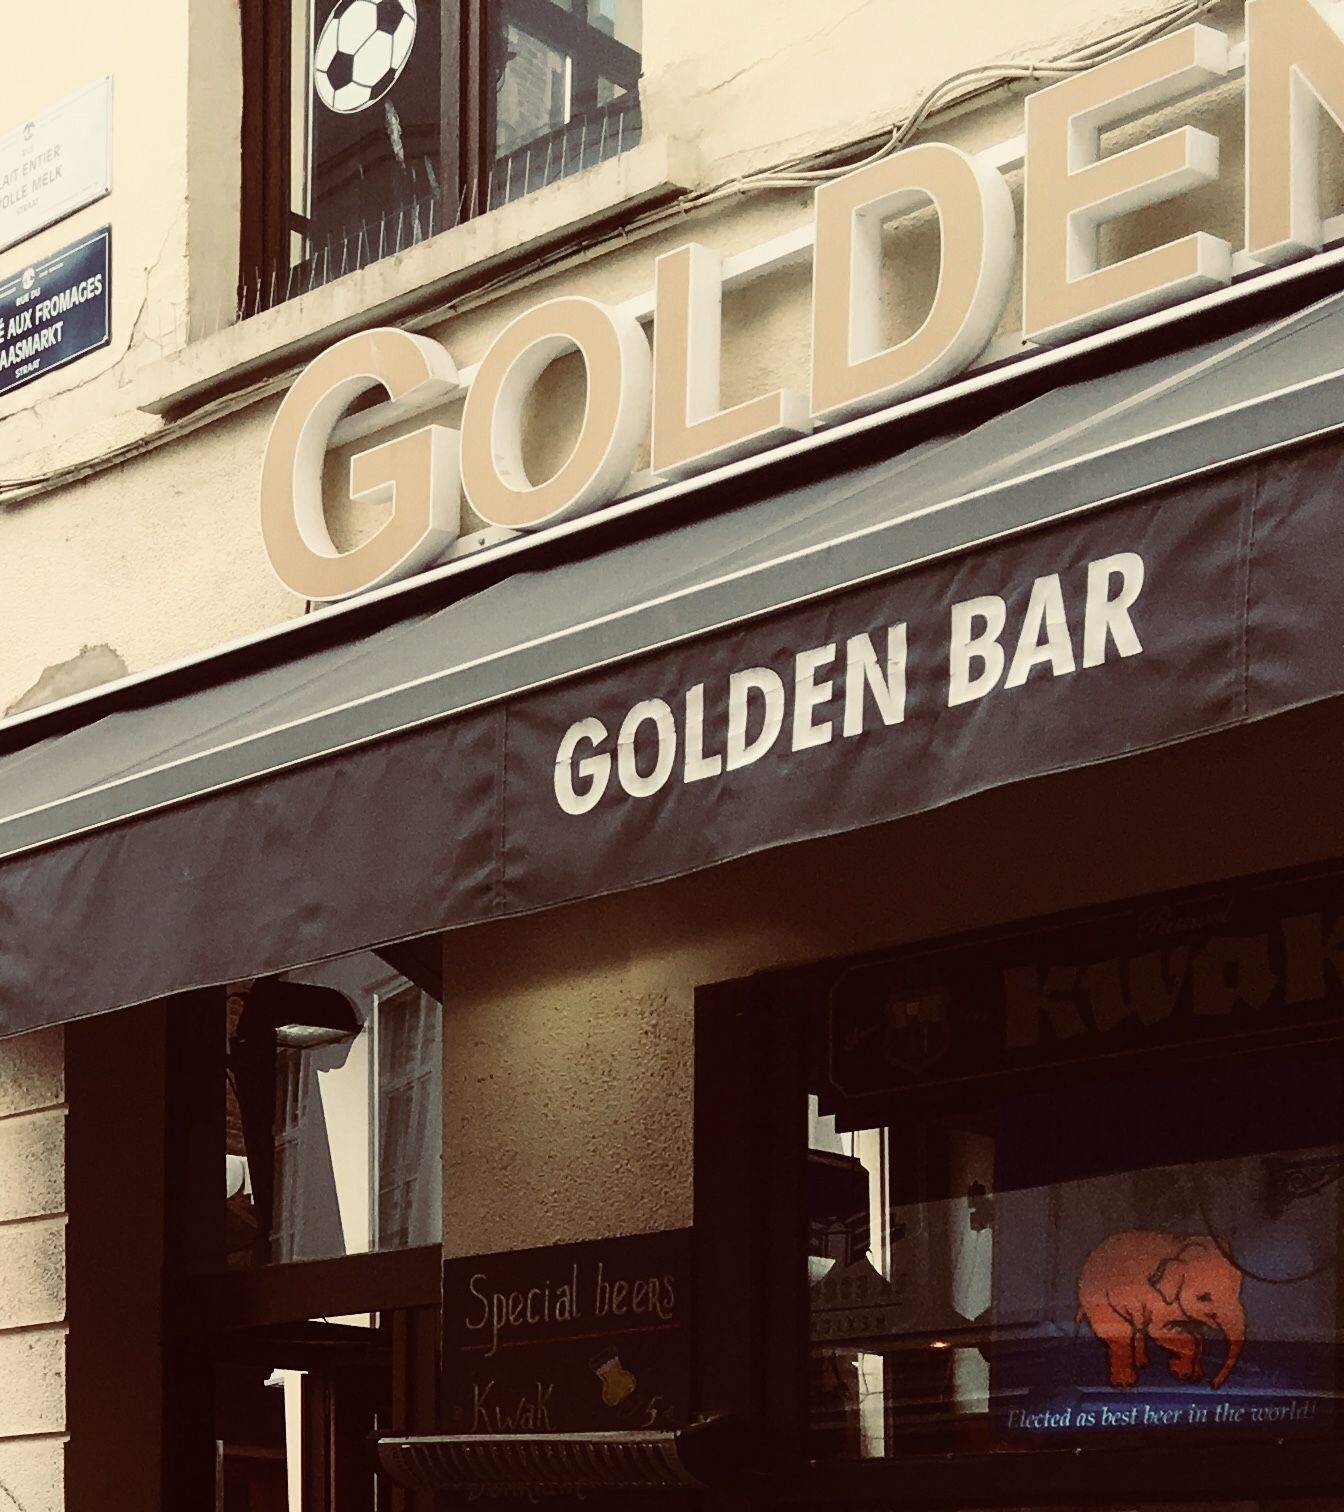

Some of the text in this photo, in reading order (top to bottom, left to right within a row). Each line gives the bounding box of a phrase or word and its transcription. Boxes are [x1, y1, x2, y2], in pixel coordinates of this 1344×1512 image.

[22, 144, 62, 177] ENTIER
[32, 164, 63, 193] MELK
[7, 308, 34, 340] AUX
[35, 273, 103, 326] FROMAGES
[30, 286, 41, 300] DU
[552, 550, 1146, 817] GOLDEN BAR
[465, 1263, 582, 1358] Special
[1075, 1412, 1096, 1427] as
[1101, 1404, 1138, 1427] best
[1143, 1404, 1182, 1427] beer
[1187, 1403, 1208, 1424] in
[1213, 1403, 1245, 1424] the
